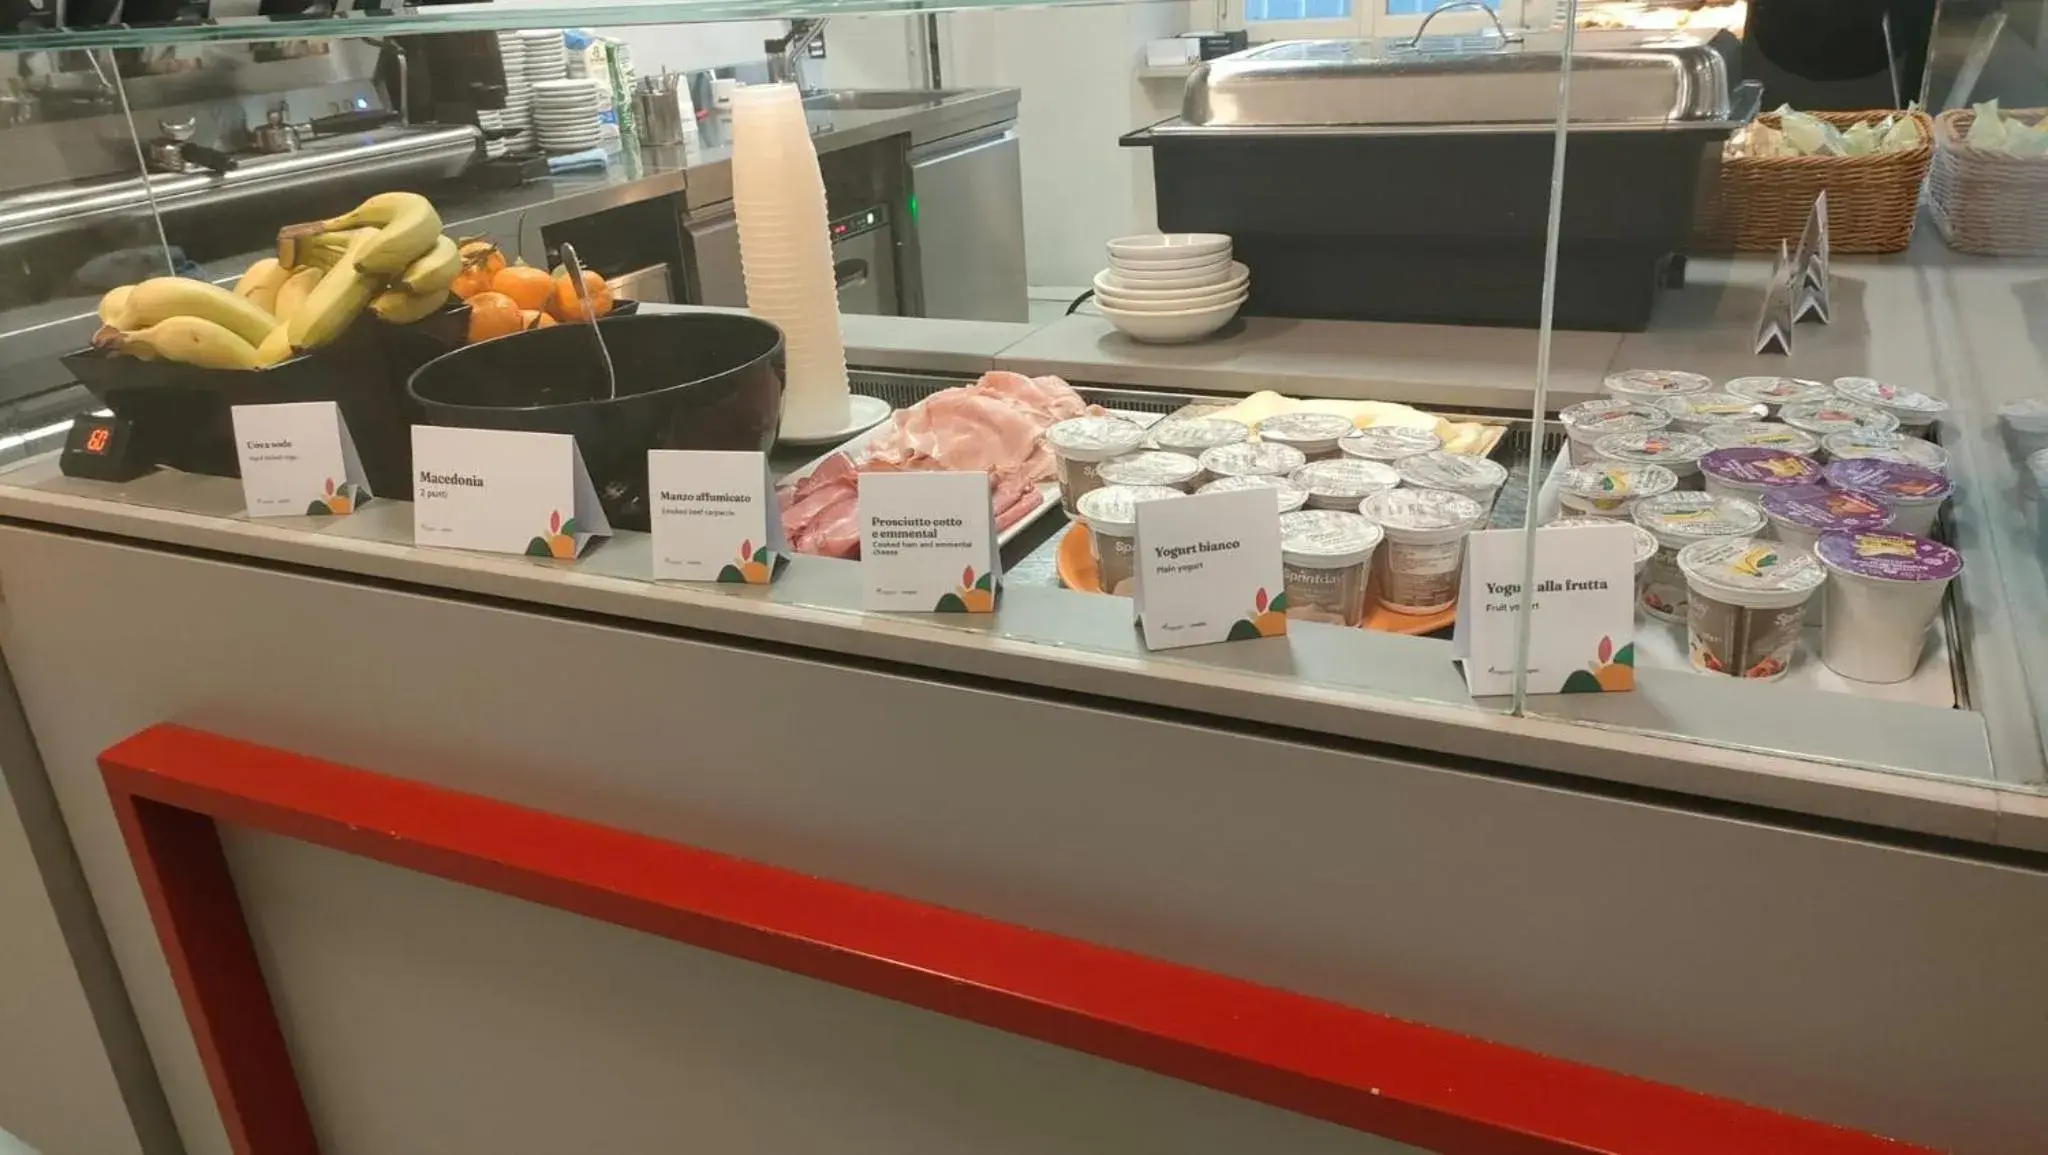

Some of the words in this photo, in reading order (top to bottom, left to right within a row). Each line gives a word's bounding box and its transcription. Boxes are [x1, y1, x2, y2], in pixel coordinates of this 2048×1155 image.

[420, 471, 484, 487] Macedonia
[420, 489, 426, 497] 2
[661, 491, 695, 501] Manzo
[695, 492, 752, 503] affumicato
[871, 516, 931, 527] Prosciutto
[932, 518, 963, 527] cotto
[871, 531, 879, 539] e
[880, 529, 938, 539] emmental
[1155, 545, 1198, 559] Yogurt
[1198, 540, 1240, 553] bianco
[1156, 564, 1176, 574] Plain
[1177, 562, 1204, 574] yogurt
[1486, 582, 1527, 596] Yogu
[1537, 580, 1563, 592] alla
[1564, 579, 1608, 591] frutta
[1485, 603, 1507, 612] Fruit
